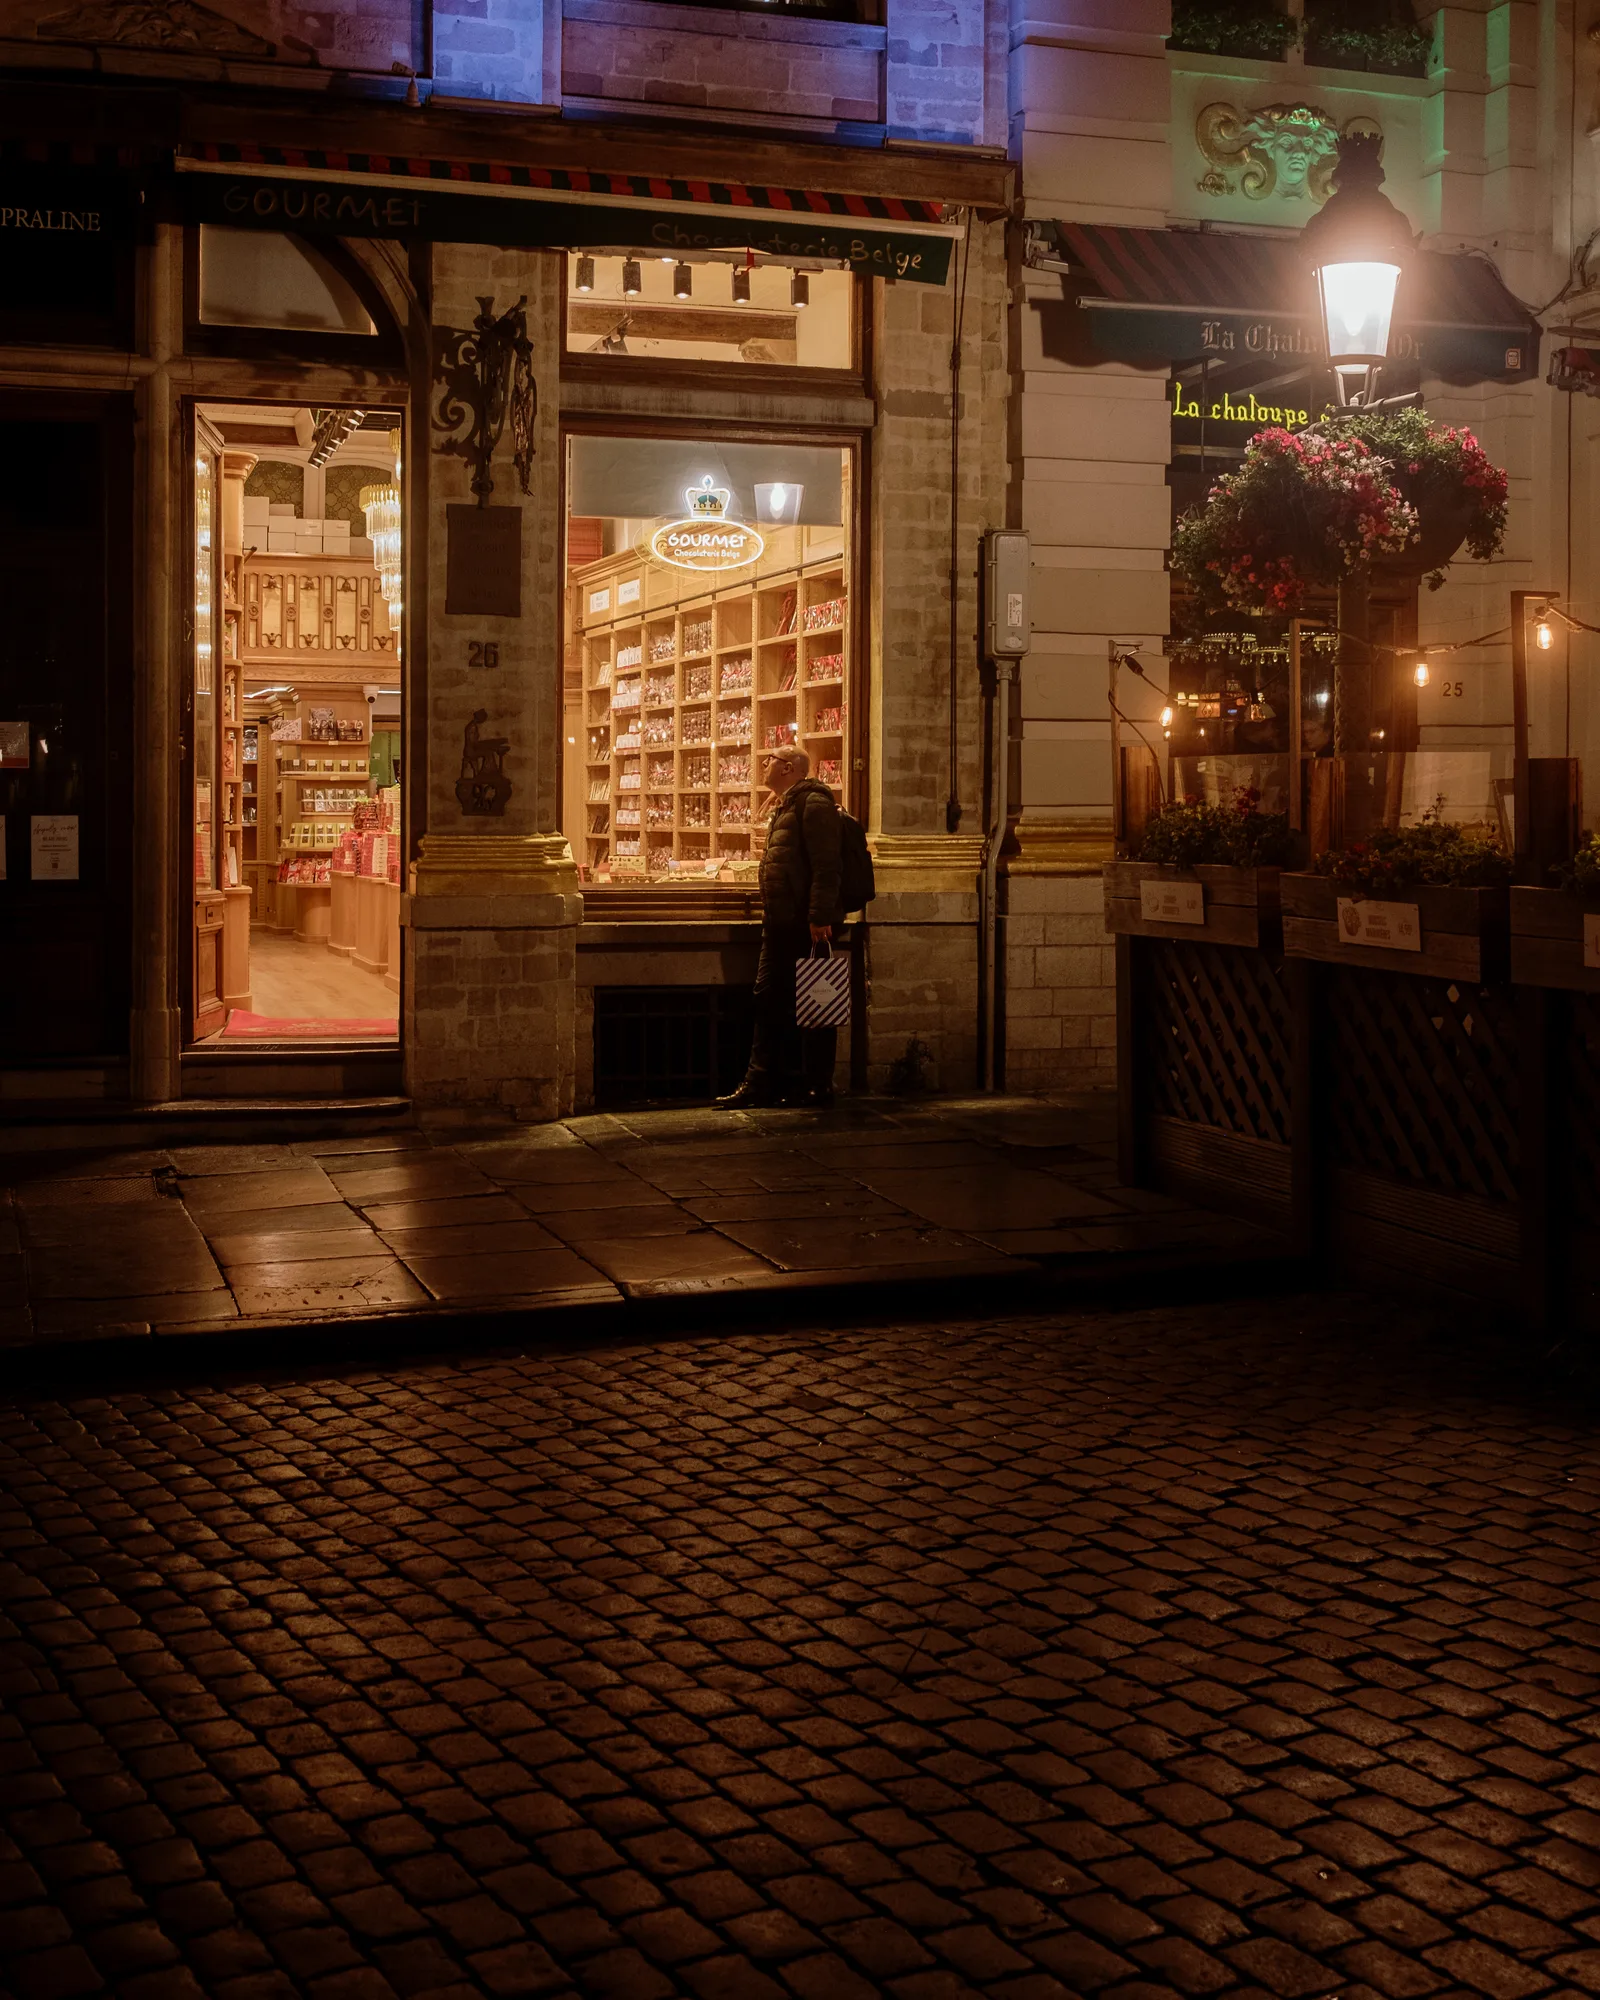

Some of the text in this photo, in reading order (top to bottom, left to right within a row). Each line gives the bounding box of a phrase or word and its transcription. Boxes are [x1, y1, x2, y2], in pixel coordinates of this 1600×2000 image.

[0, 207, 101, 232] PRALINE
[223, 185, 428, 229] GOURMET
[848, 239, 923, 275] Belge
[1201, 321, 1236, 350] La
[1173, 381, 1200, 418] La
[1212, 392, 1309, 431] chaloupe
[668, 532, 748, 548] GOURMET
[468, 640, 499, 668] 26
[1443, 681, 1463, 697] 25
